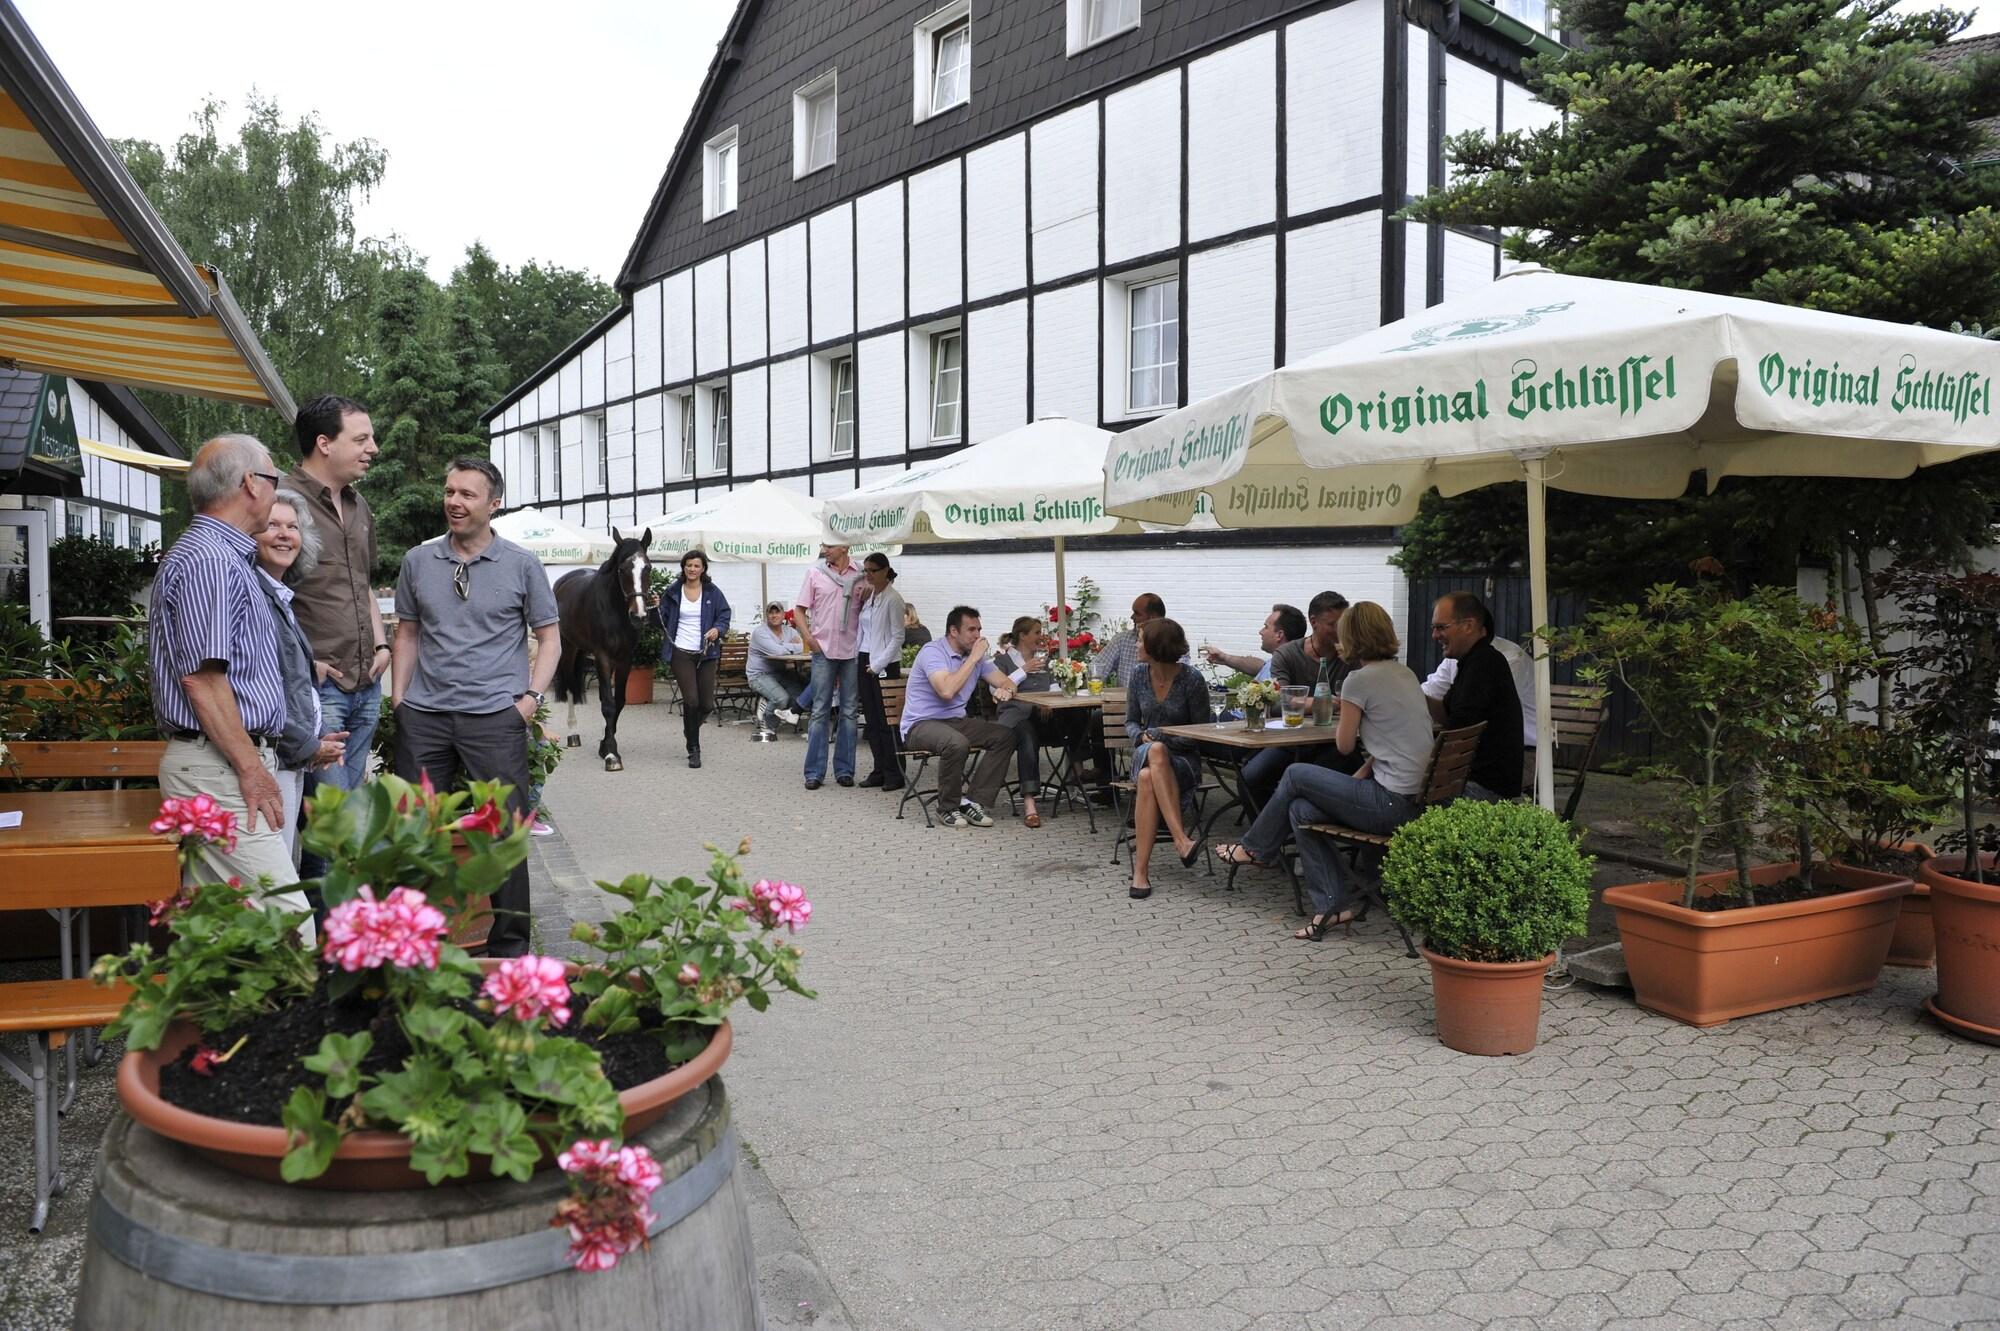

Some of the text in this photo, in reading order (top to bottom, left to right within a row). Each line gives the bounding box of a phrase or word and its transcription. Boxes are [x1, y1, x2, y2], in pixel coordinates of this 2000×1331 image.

[1320, 355, 1677, 435] Original Schlüssel
[1758, 351, 1991, 427] Original Schlüssel
[1113, 436, 1175, 482] Original
[829, 511, 867, 533] Original
[944, 501, 1025, 527] Original
[1032, 493, 1104, 524] Schlüsse
[713, 540, 762, 555] Original
